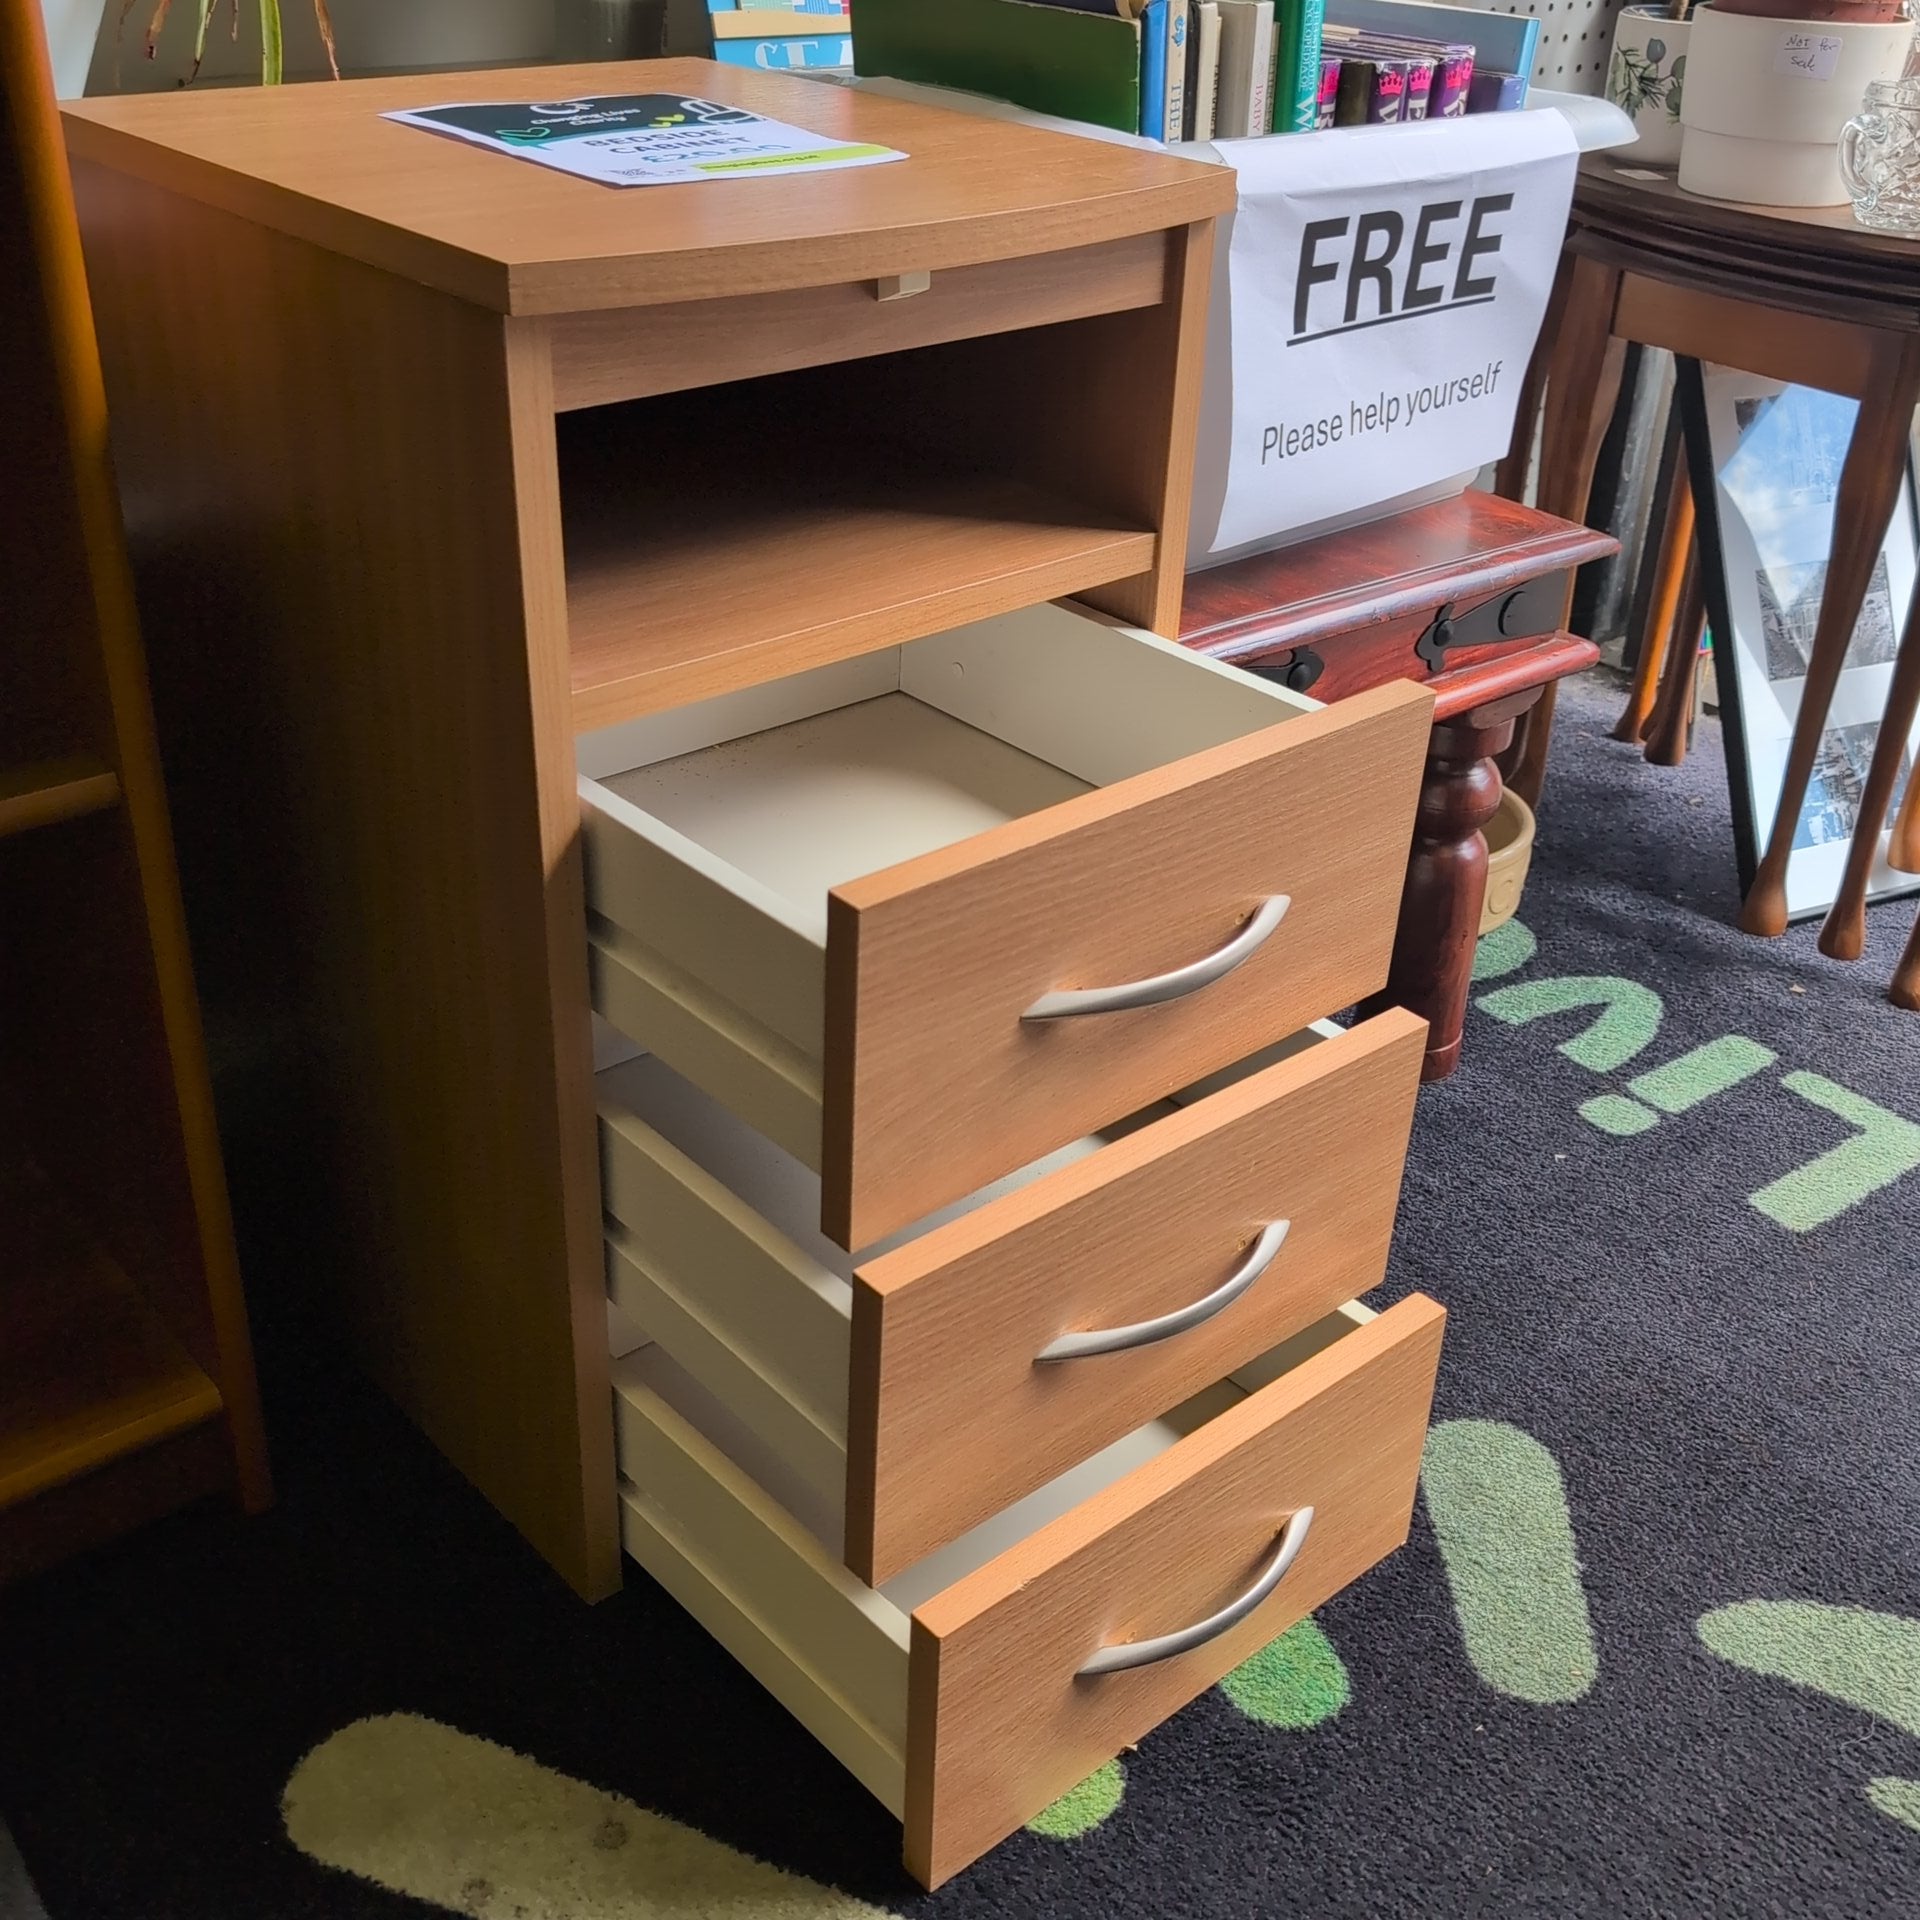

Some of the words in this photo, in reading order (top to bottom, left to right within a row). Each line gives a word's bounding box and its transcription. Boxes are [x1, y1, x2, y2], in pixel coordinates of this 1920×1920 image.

[530, 113, 604, 125] Changing
[601, 108, 642, 117] Lives
[569, 116, 628, 126] Charity
[1169, 79, 1182, 130] THE
[1252, 83, 1264, 131] BABY
[584, 128, 729, 148] BEDSIDE
[610, 135, 752, 154] CABINET
[1292, 192, 1515, 336] FREE
[1261, 414, 1343, 466] Please
[1350, 391, 1400, 437] help
[1406, 360, 1504, 429] yourself
